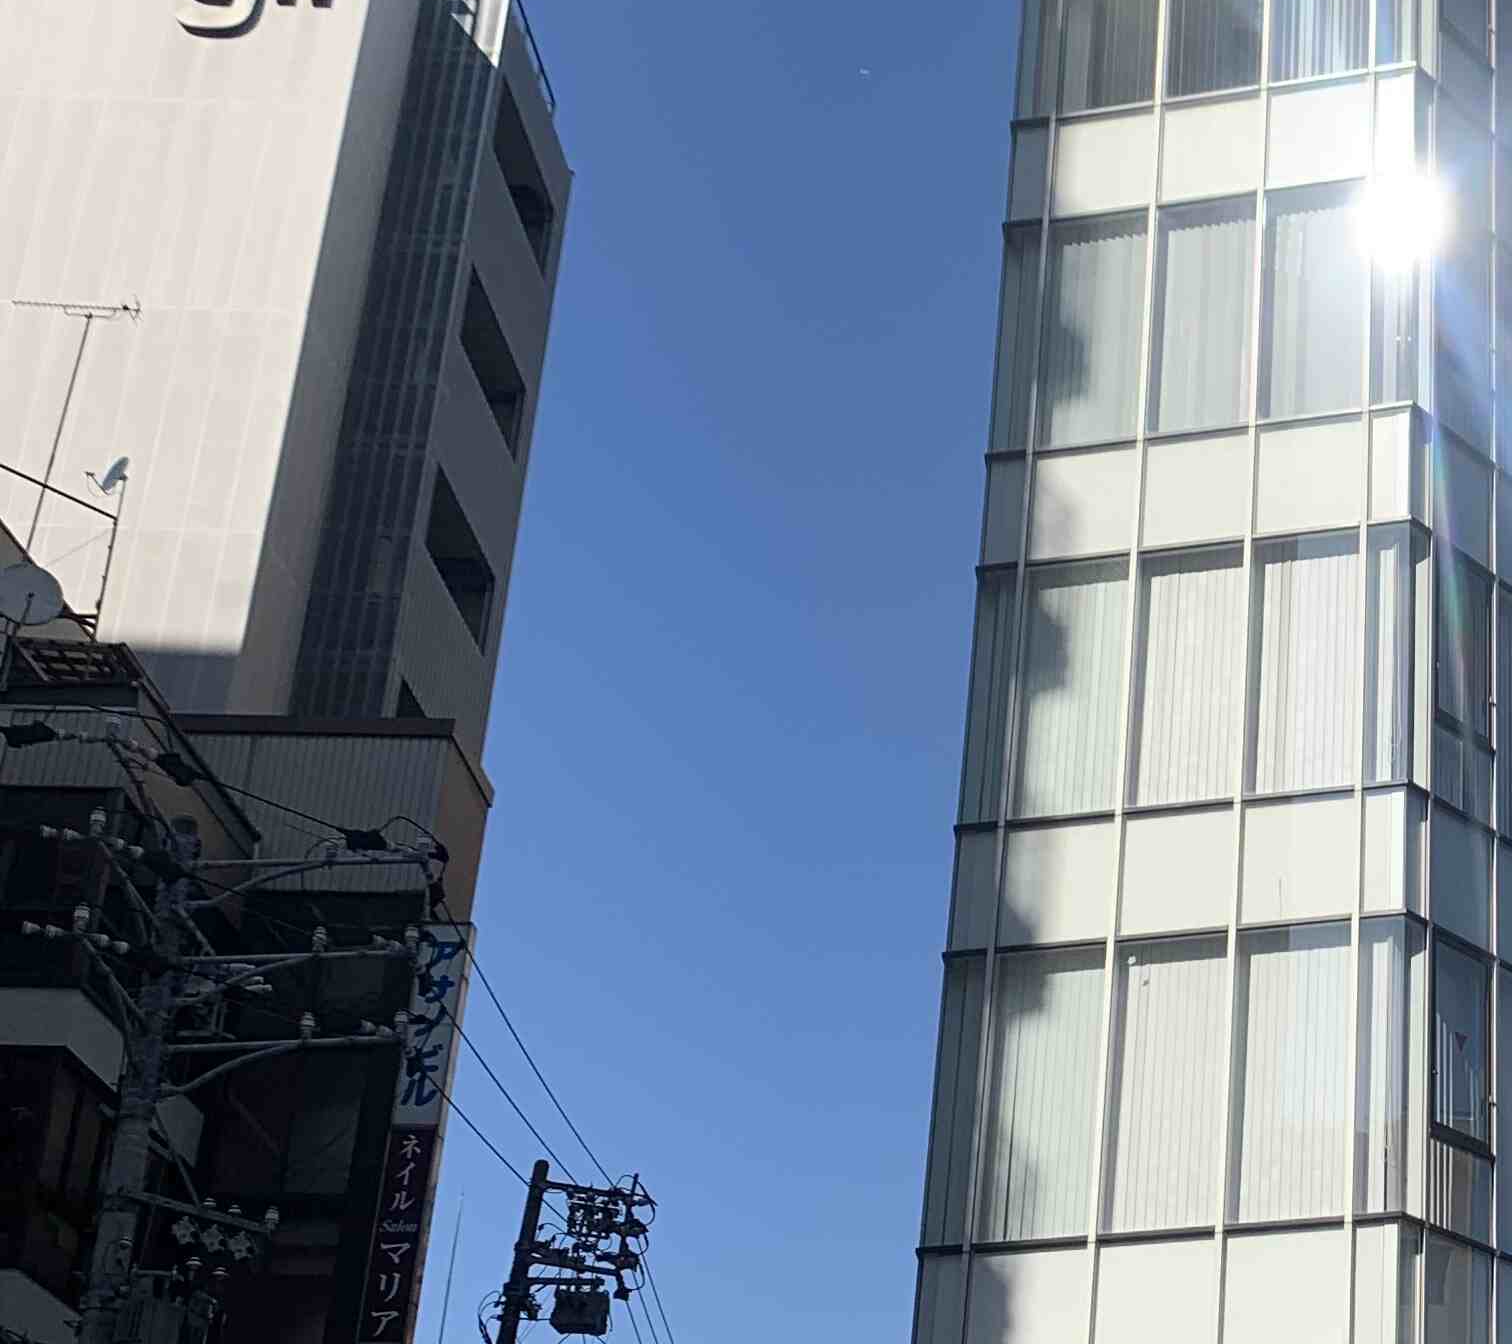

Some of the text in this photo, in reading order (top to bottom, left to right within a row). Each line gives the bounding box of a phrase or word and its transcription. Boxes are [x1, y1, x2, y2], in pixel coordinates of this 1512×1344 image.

[388, 1135, 422, 1212] ネイル
[369, 1241, 412, 1338] マリア
